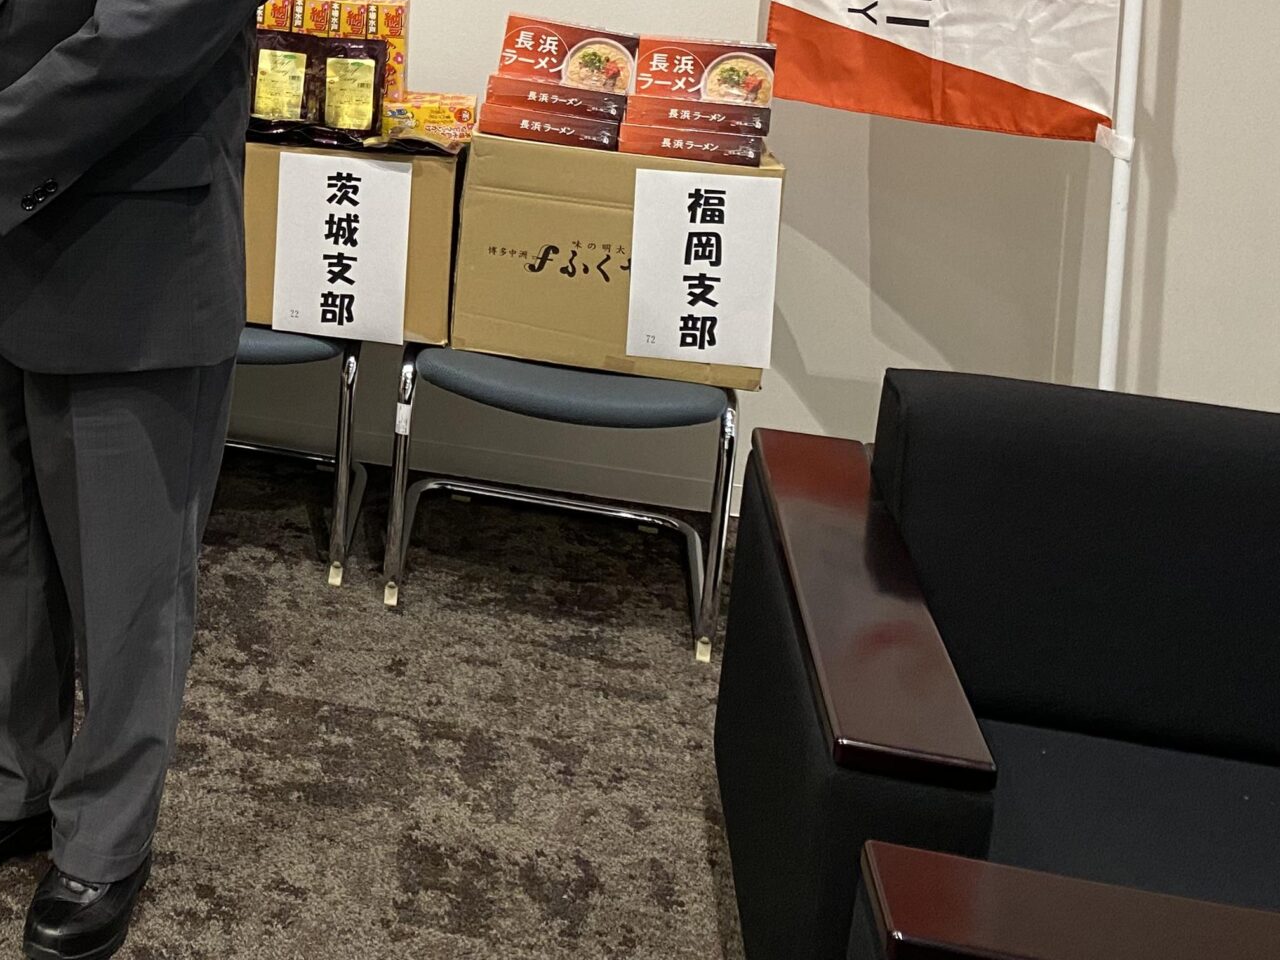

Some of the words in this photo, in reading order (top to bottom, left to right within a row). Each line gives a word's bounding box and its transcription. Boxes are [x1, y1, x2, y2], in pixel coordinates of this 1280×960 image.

[515, 30, 559, 55] 長浜
[502, 48, 567, 73] ラーメン
[649, 52, 694, 75] 長浜
[637, 72, 705, 93] ラーメン
[320, 171, 362, 327] 茨城支部
[679, 187, 728, 351] 福岡支部
